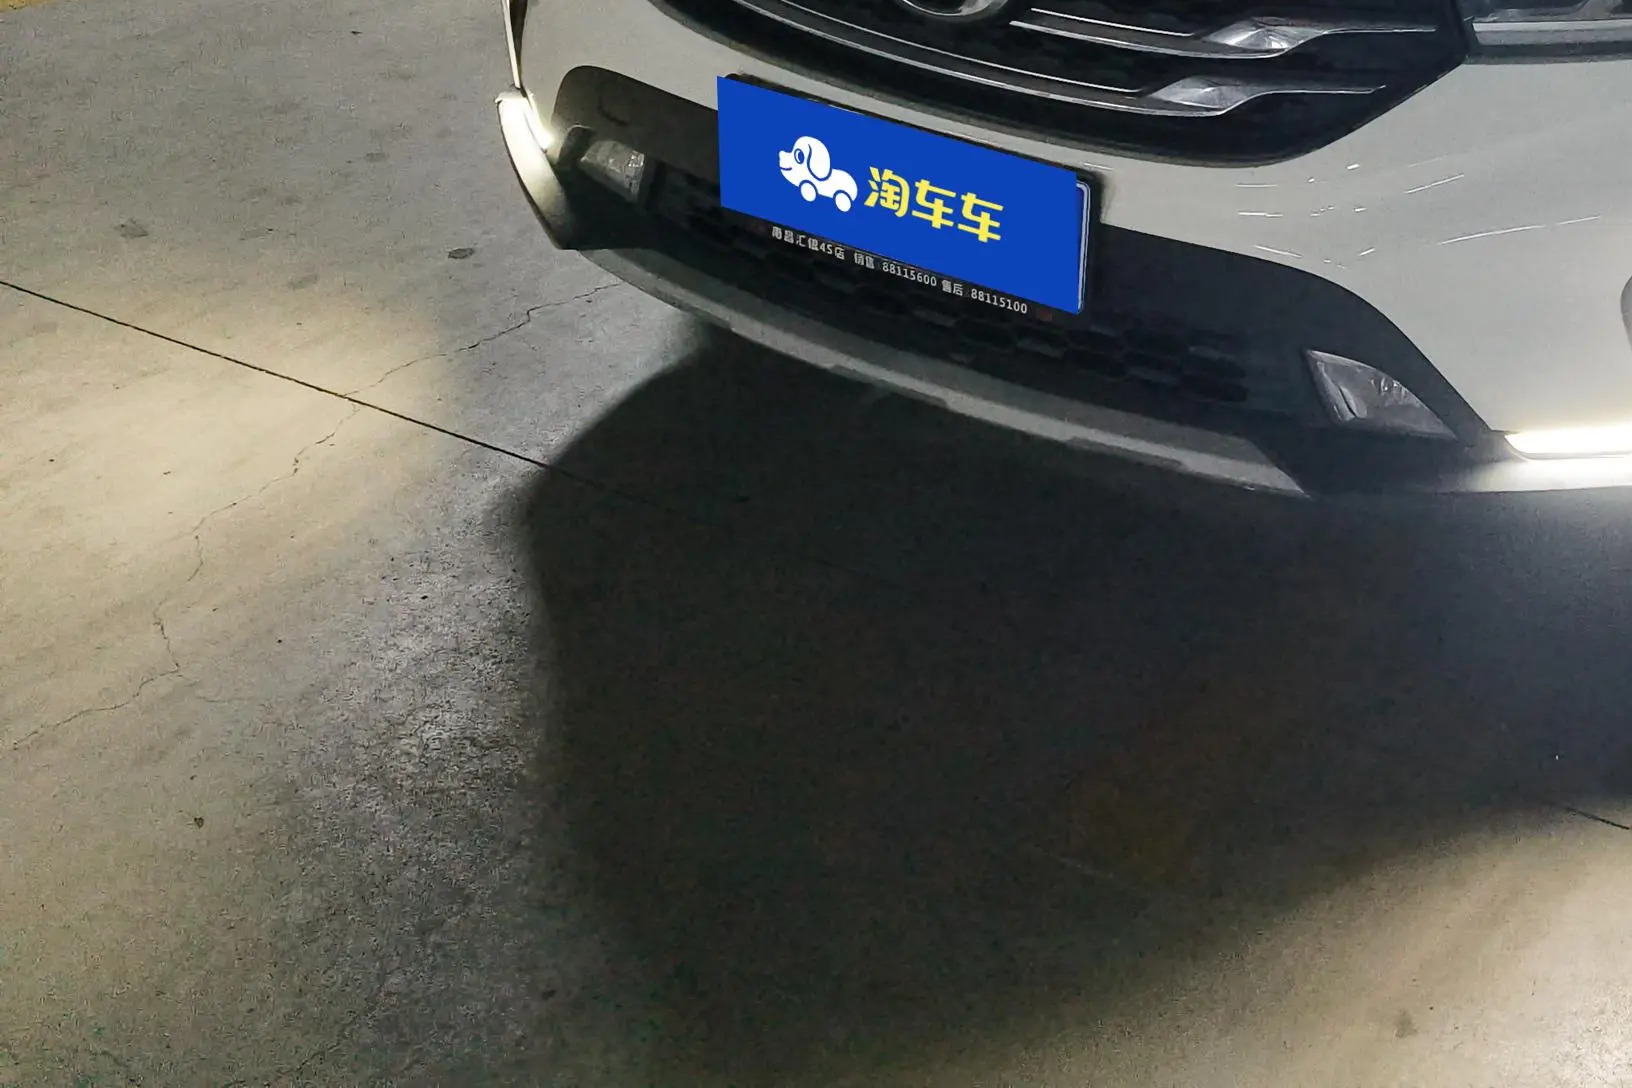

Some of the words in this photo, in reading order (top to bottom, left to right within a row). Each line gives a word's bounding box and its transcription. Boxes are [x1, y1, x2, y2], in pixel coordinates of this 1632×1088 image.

[881, 262, 937, 287] 88115600
[941, 279, 963, 297] 售后
[970, 288, 1028, 315] 88115100
